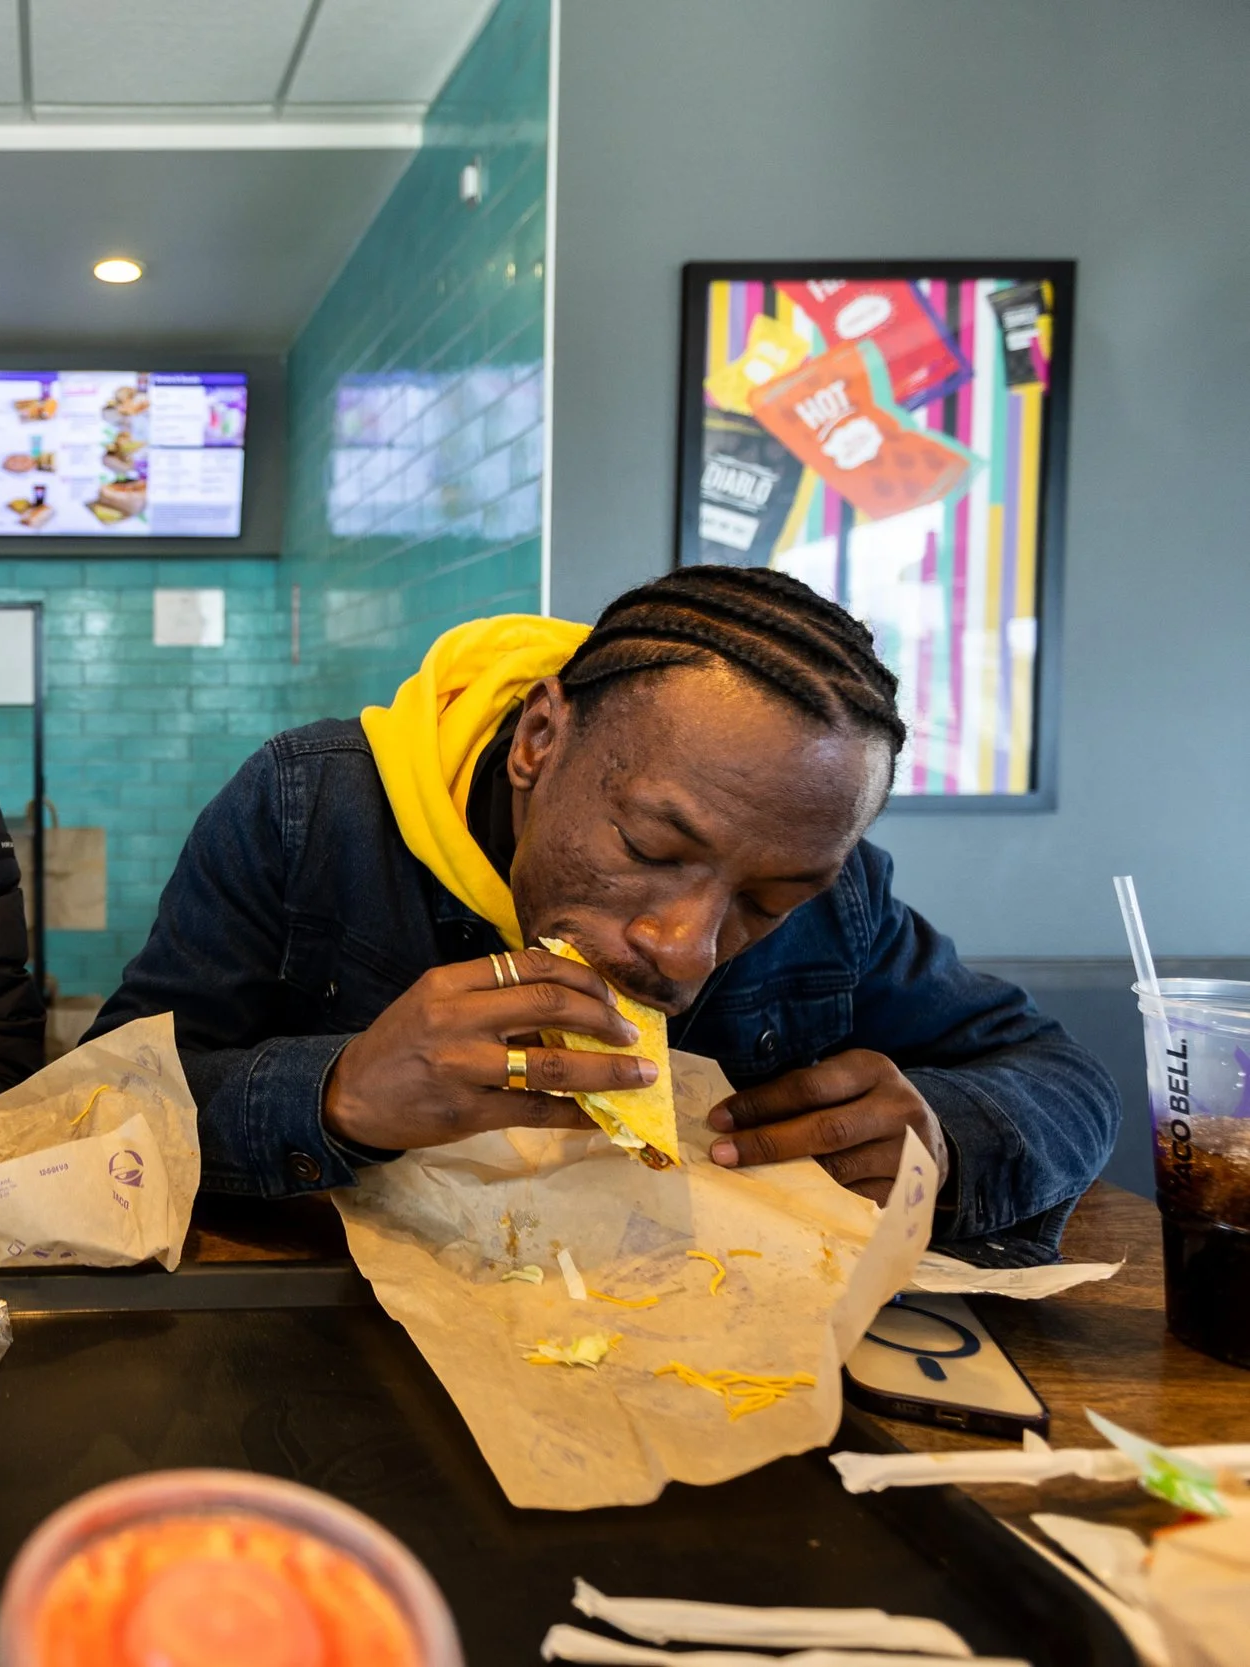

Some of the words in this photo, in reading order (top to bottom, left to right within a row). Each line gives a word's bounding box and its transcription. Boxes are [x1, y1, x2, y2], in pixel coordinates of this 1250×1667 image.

[794, 380, 851, 430] HOT
[700, 462, 774, 505] DIABLO
[111, 1190, 130, 1210] TACO
